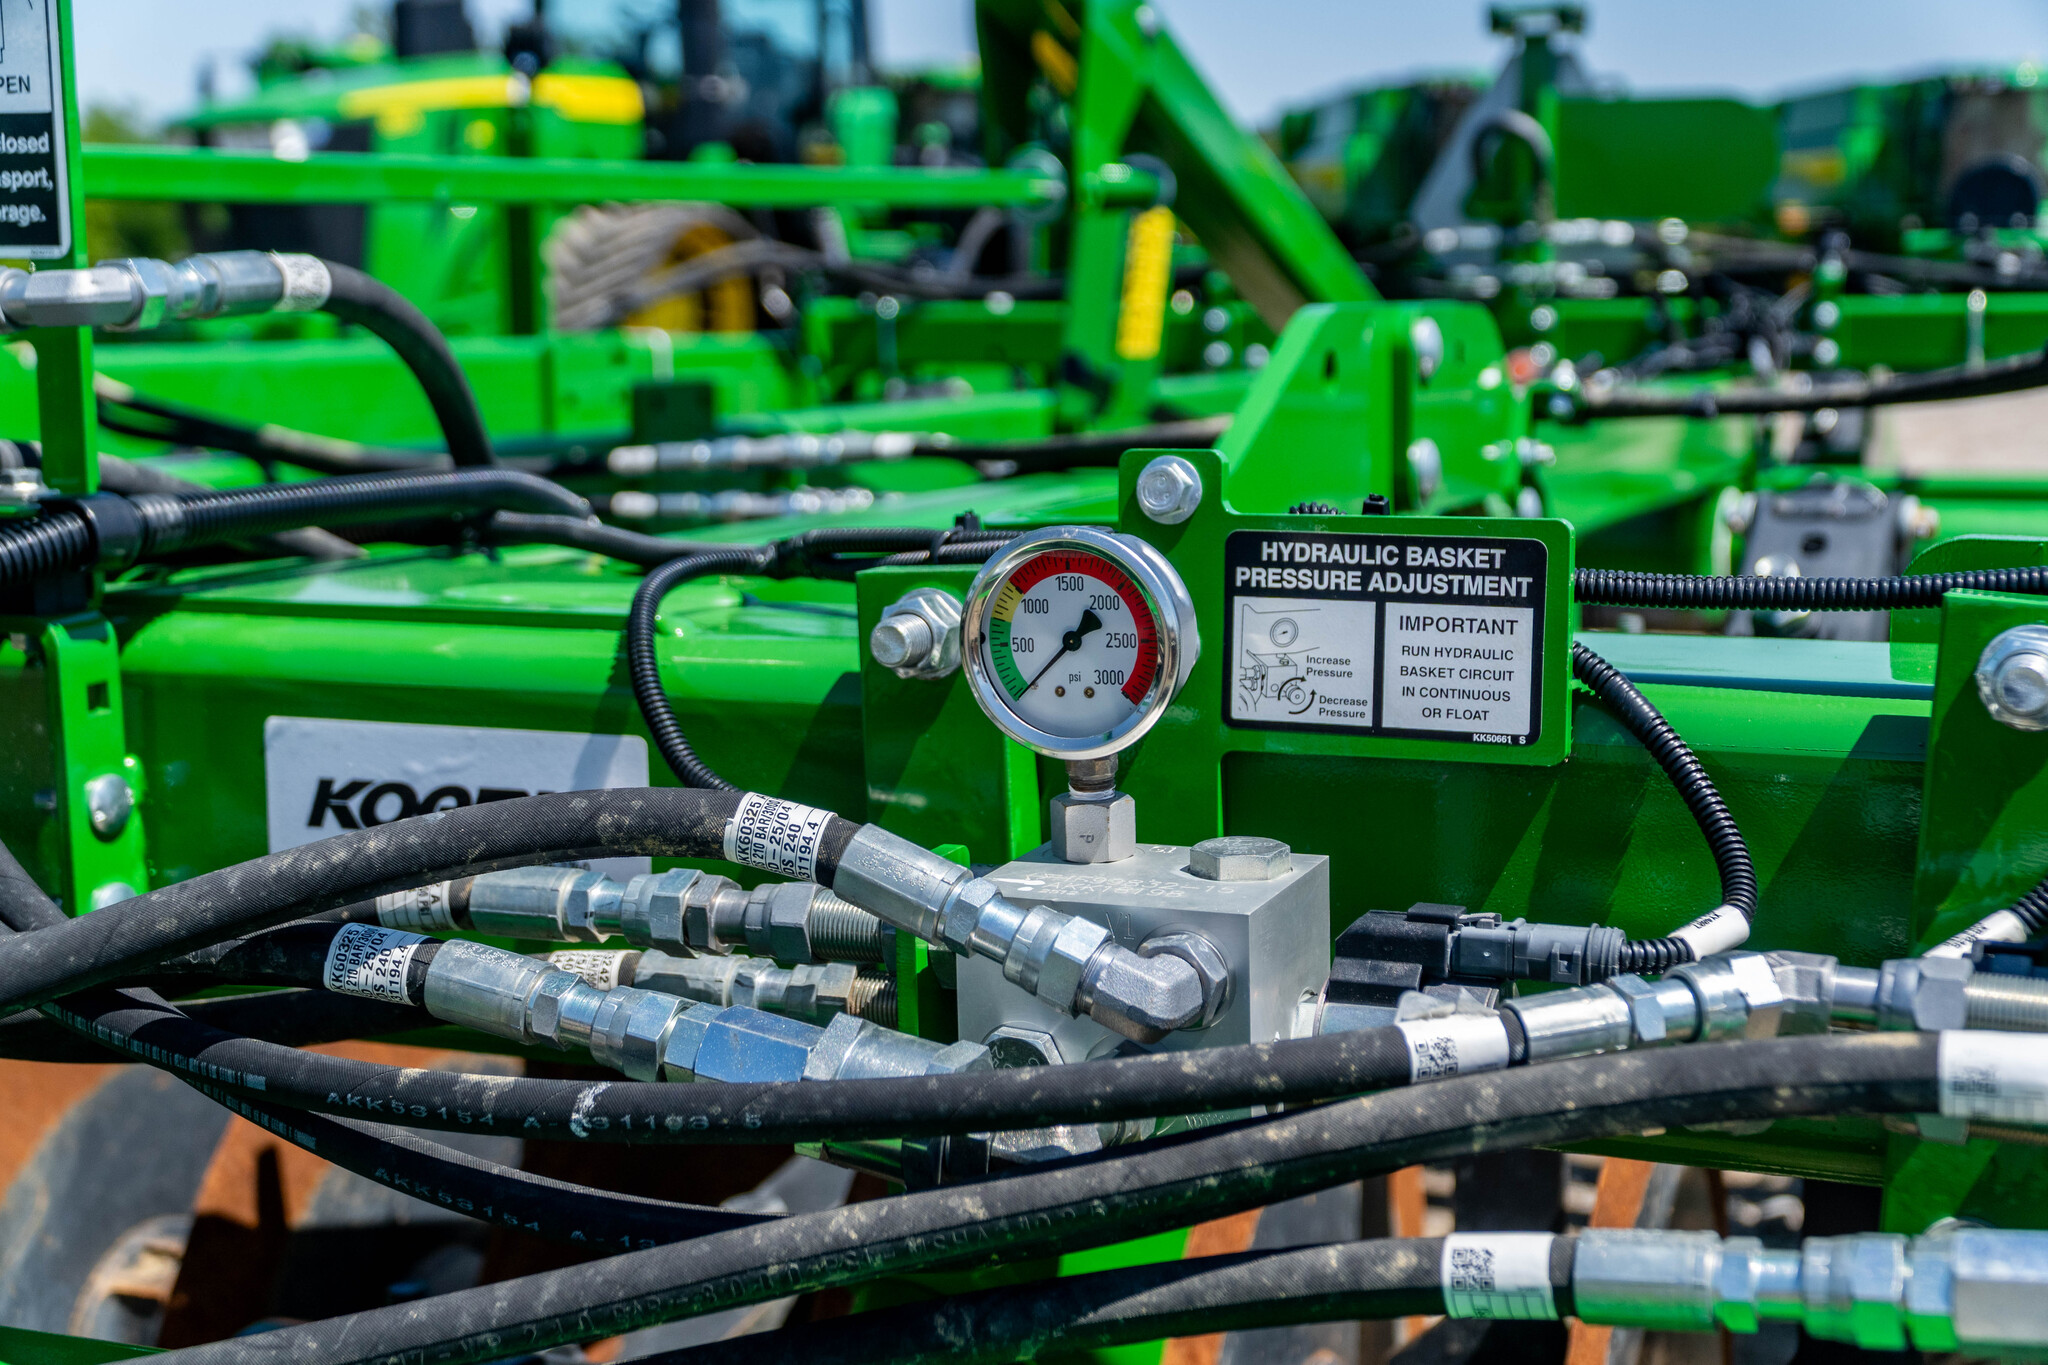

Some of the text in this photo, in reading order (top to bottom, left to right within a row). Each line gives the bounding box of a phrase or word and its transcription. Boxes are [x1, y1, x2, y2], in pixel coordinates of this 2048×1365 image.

[0, 131, 50, 154] losed
[0, 166, 54, 192] sport,
[0, 202, 47, 228] rage.
[1261, 541, 1506, 569] HYDRAULIC BASKET
[1055, 575, 1085, 592] 1500
[1234, 566, 1533, 597] PRESSURE ADJUSTMENT
[1021, 598, 1049, 614] 1000
[1089, 594, 1120, 611] 2000
[1399, 615, 1518, 635] IMPORTANT
[1012, 637, 1035, 653] 500
[1105, 632, 1137, 649] 2500
[1306, 655, 1351, 666] Increase
[1401, 645, 1514, 661] RUN HYDRAULIC
[1068, 671, 1081, 684] psi
[1094, 669, 1124, 686] 3000
[1306, 667, 1353, 678] Pressure
[1400, 665, 1514, 681] BASKET CIRCUIT
[1319, 695, 1368, 707] Decrease
[1402, 686, 1511, 702] IN CONTINUOUS
[1318, 708, 1366, 718] Pressure
[1421, 707, 1490, 721] OR FLOAT
[1473, 733, 1526, 745] KK50661 S
[737, 801, 762, 866] KK60325
[769, 805, 792, 846] 25/04
[783, 823, 801, 853] 240
[362, 931, 389, 971] 25/04
[376, 948, 392, 977] 240
